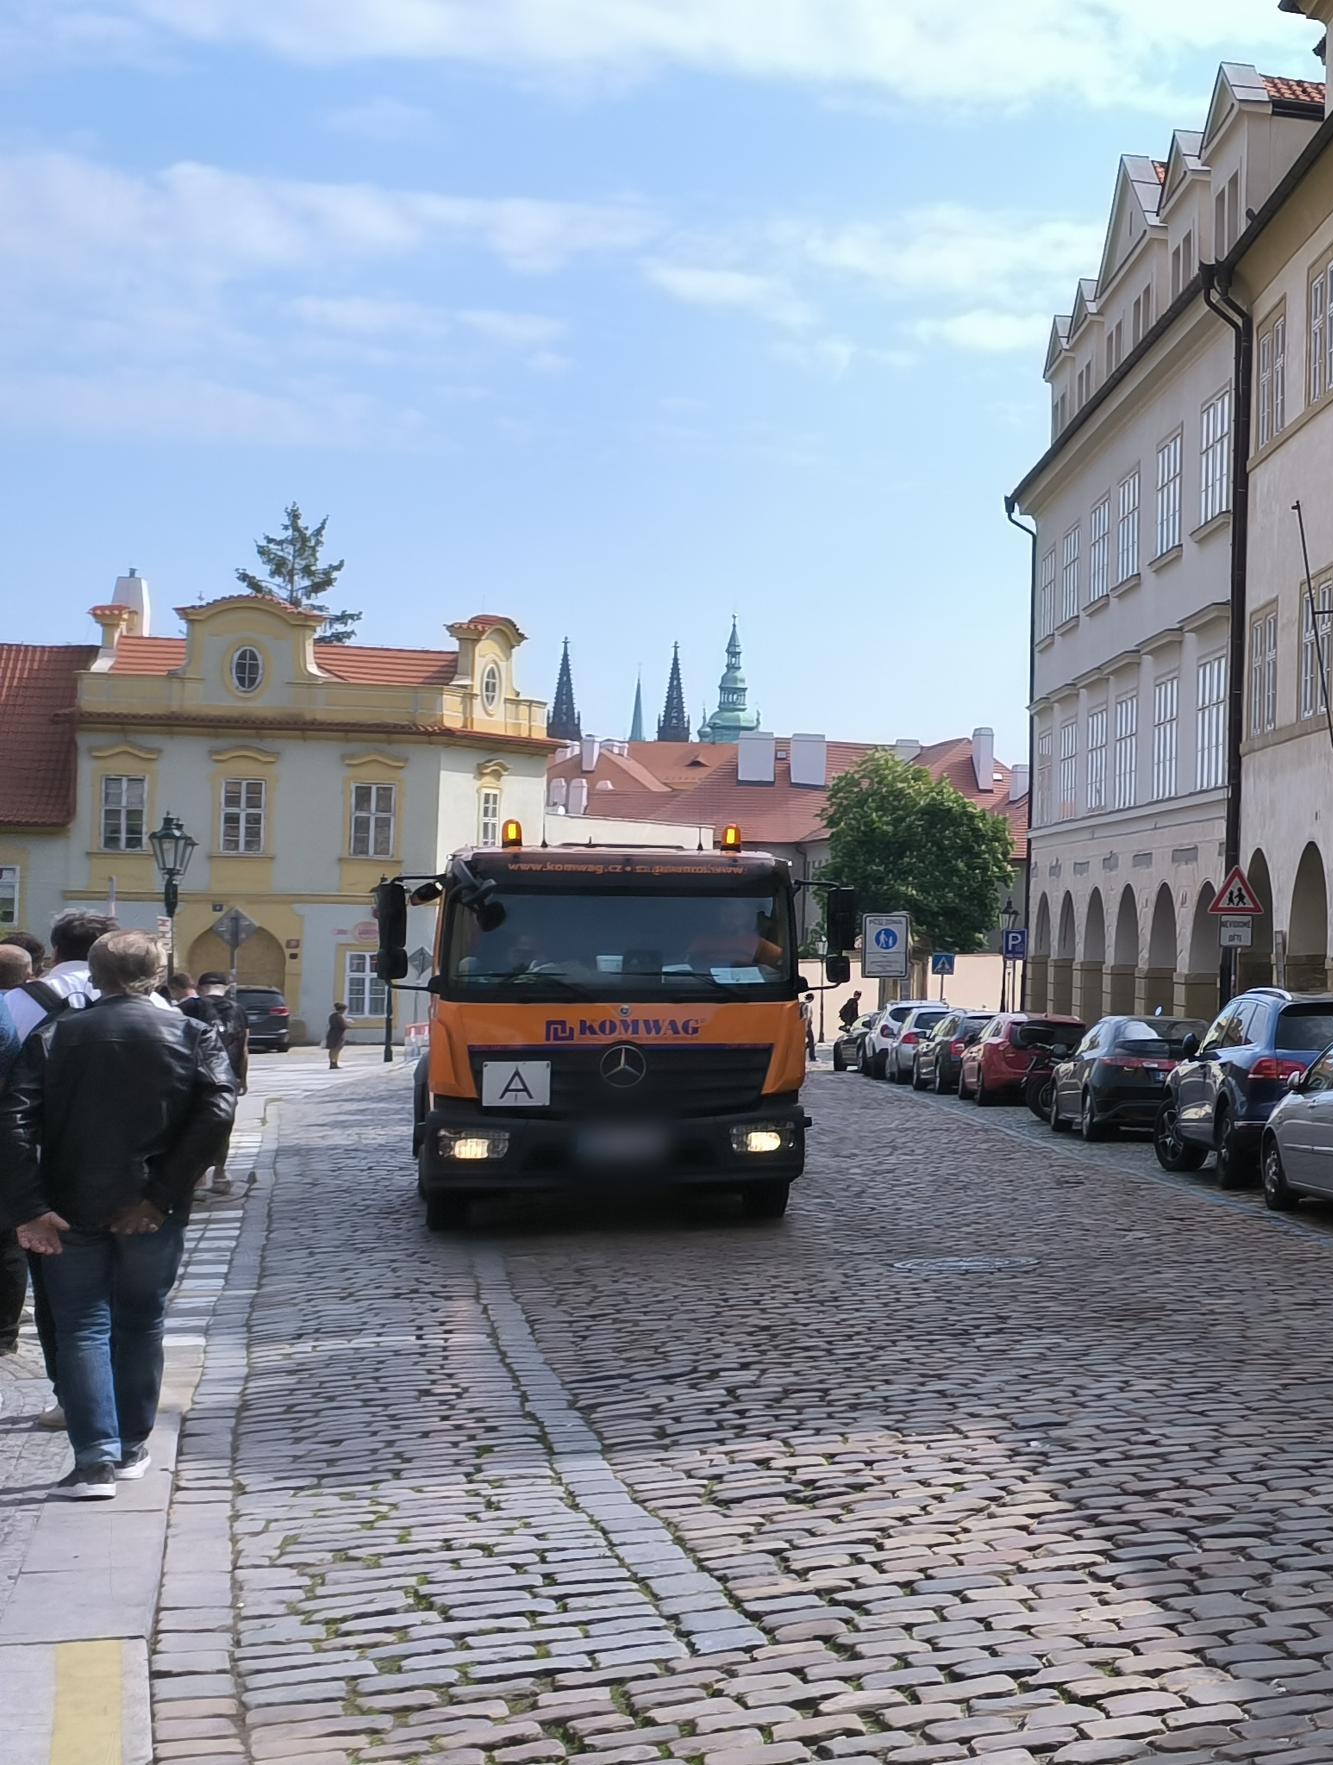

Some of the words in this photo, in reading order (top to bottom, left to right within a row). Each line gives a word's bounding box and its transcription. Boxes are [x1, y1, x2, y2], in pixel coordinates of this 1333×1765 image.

[507, 861, 624, 875] www.komwag.cz
[1008, 932, 1022, 951] P
[578, 1018, 701, 1037] KOMWAG
[498, 1065, 534, 1101] A
